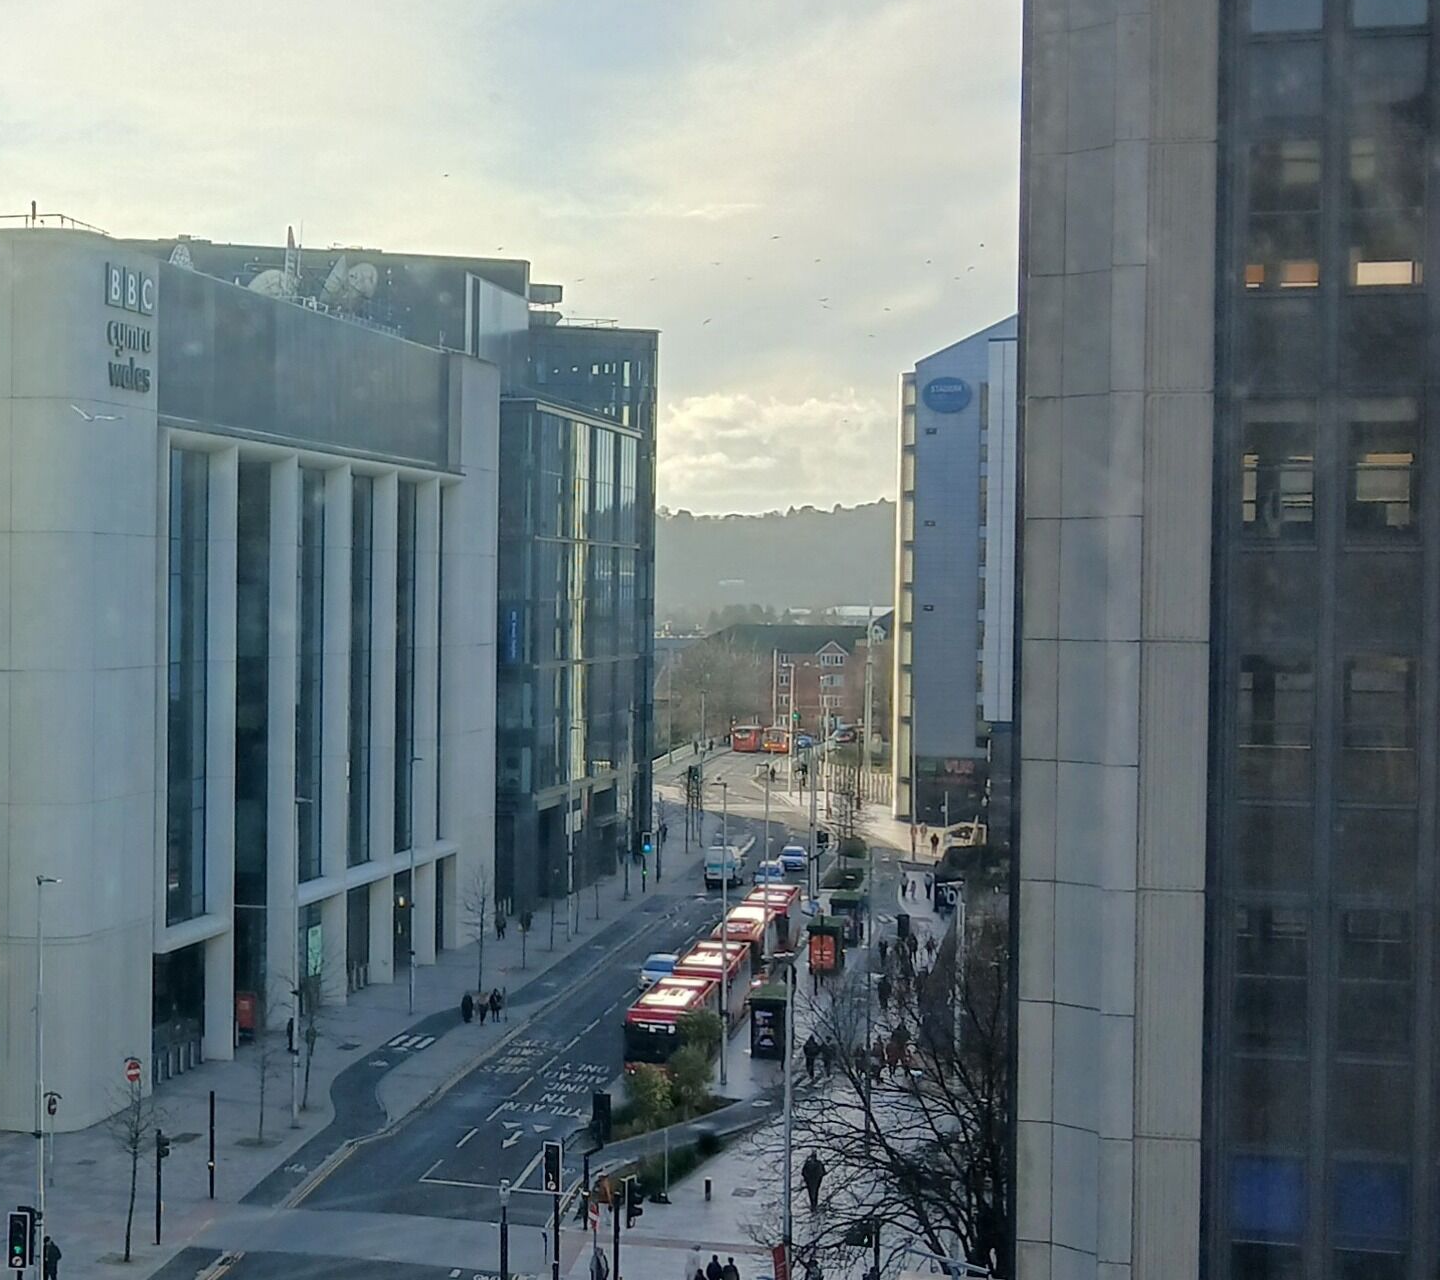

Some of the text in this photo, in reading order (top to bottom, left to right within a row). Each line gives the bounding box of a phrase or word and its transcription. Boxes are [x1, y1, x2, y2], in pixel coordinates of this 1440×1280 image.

[108, 265, 153, 313] BBC
[107, 320, 151, 357] cymru
[108, 357, 151, 393] wales
